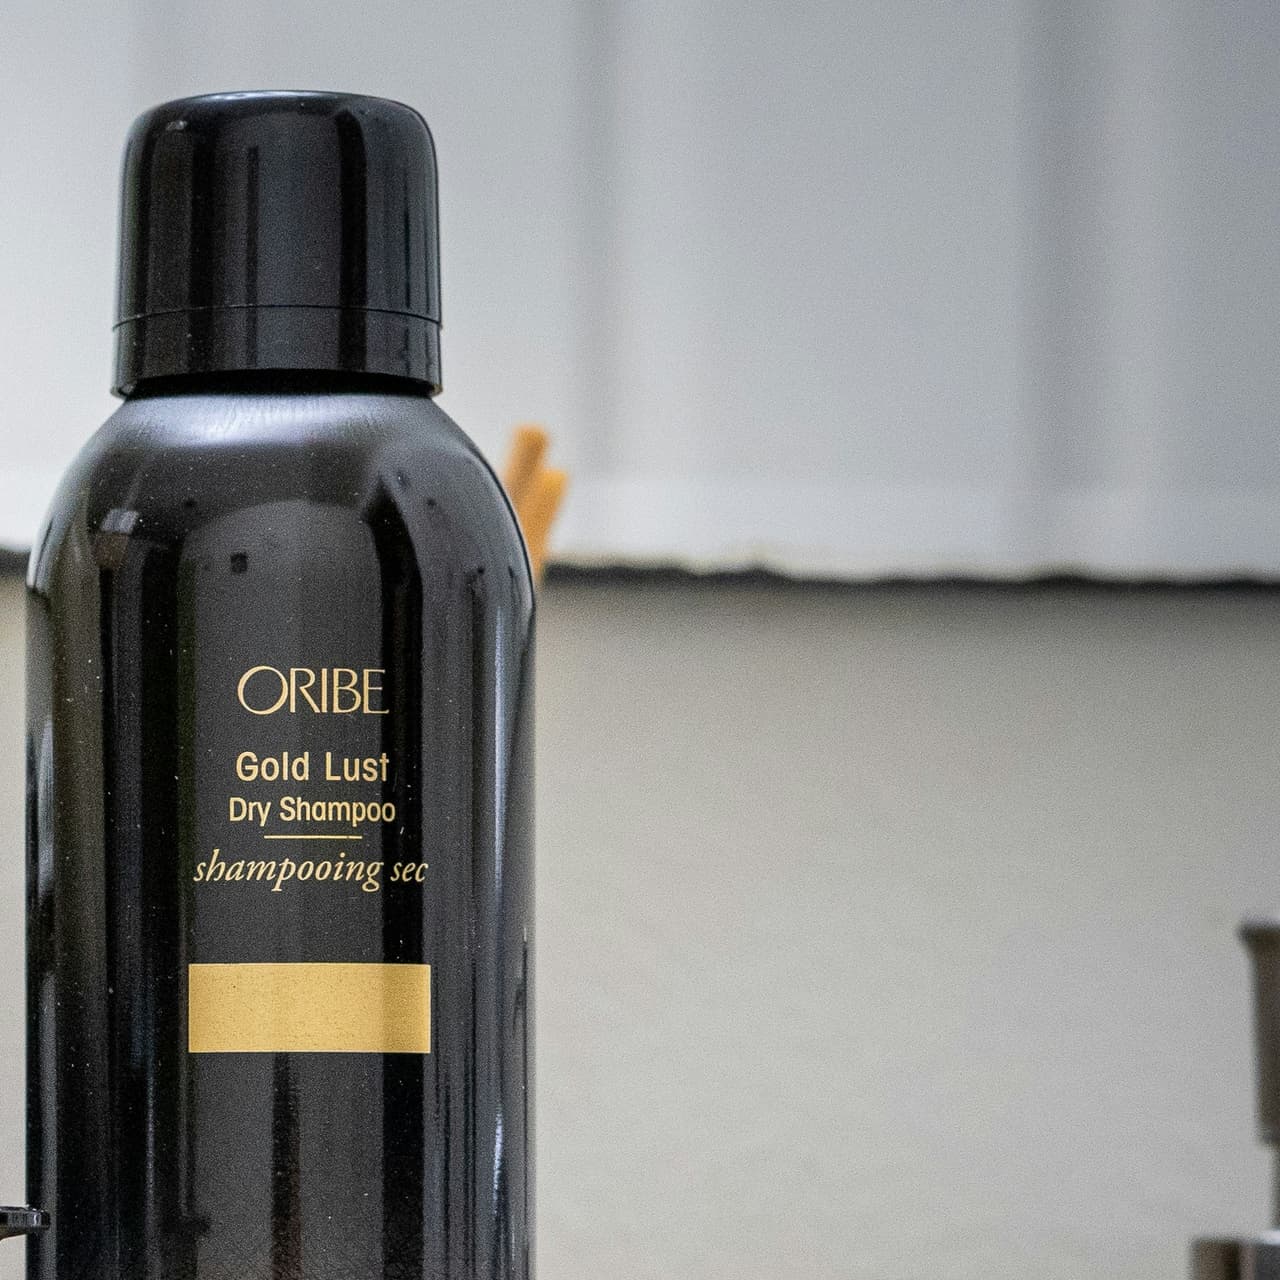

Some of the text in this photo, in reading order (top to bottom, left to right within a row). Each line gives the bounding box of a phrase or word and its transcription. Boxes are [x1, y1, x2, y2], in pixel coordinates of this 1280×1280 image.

[237, 665, 389, 716] ORIBE
[236, 751, 390, 782] Gold Lust
[229, 796, 396, 827] Dry Shampoo
[192, 848, 429, 893] shampooing sec
